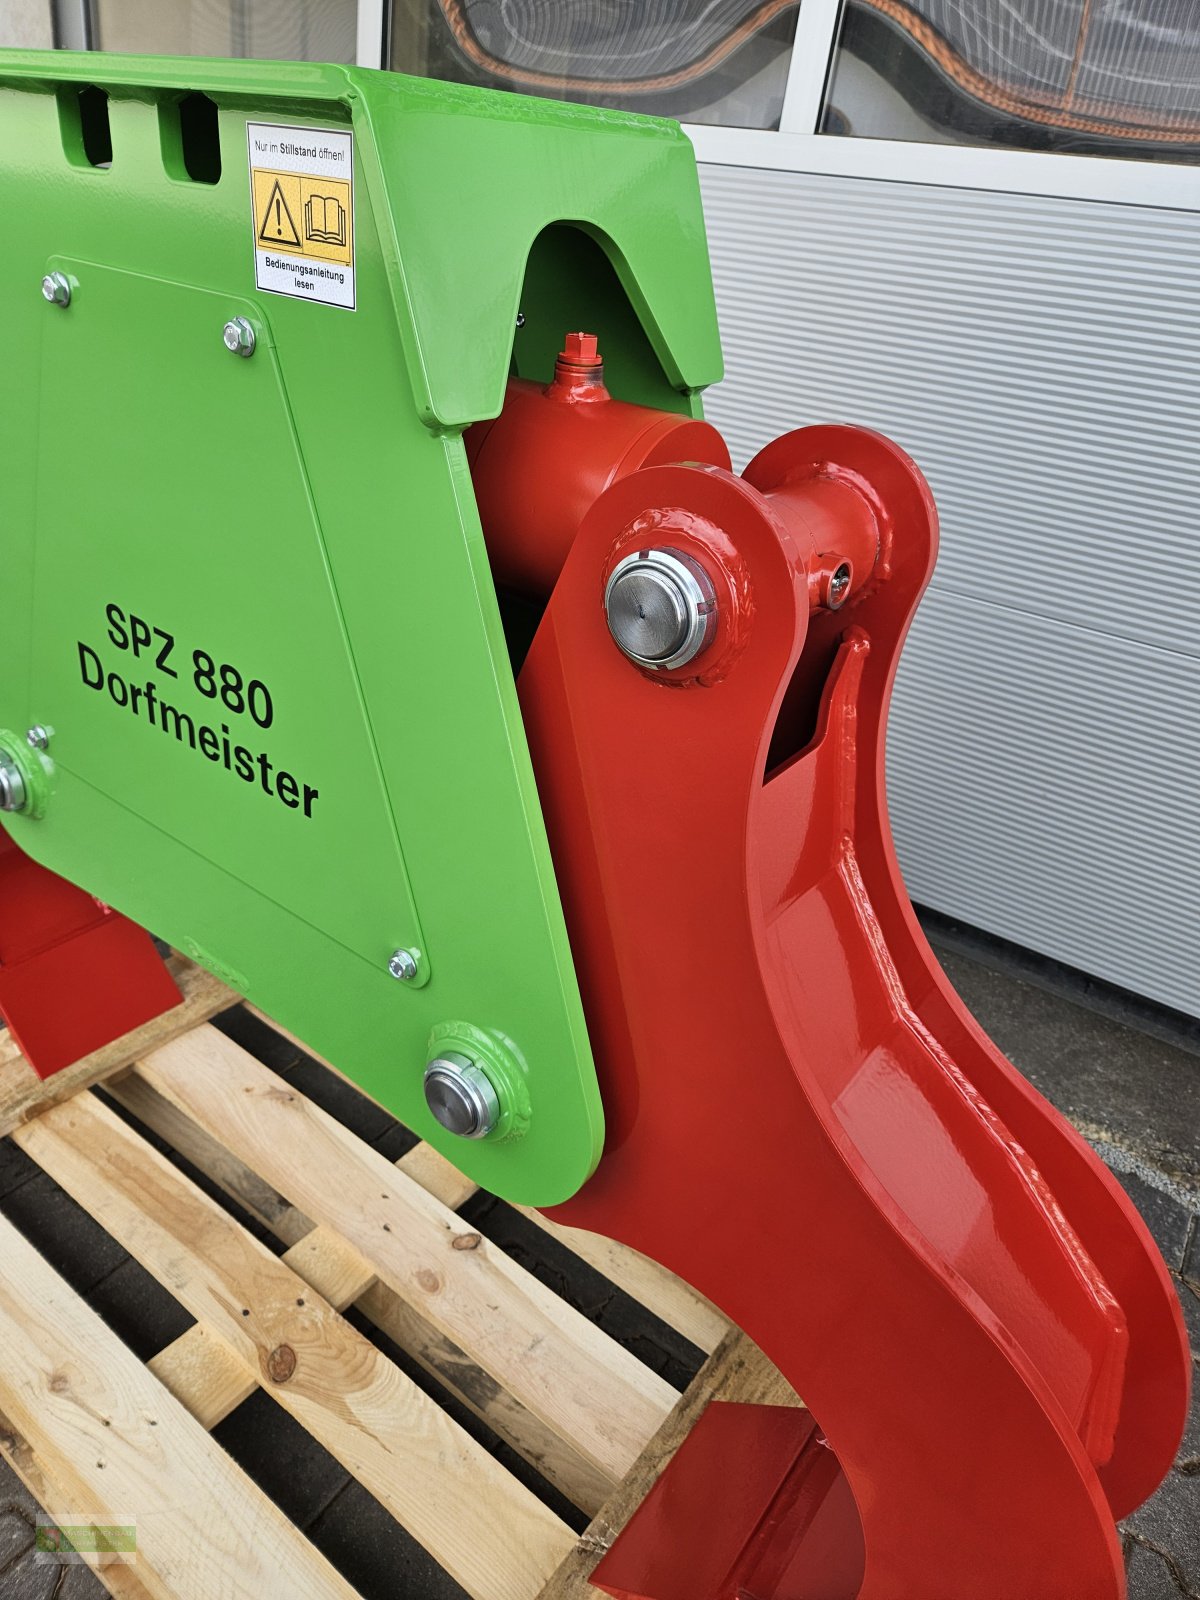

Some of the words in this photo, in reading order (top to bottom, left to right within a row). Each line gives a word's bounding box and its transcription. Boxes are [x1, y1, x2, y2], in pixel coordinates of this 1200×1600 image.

[255, 140, 268, 152] Nur
[269, 143, 279, 153] im
[280, 143, 317, 158] Stillstand
[318, 147, 345, 161] öffnen!
[265, 257, 345, 284] Bedienungsanleitung
[295, 278, 315, 291] lesen
[105, 603, 178, 680] SPZ
[192, 649, 274, 729] 880
[77, 640, 319, 819] Dorfmeister
